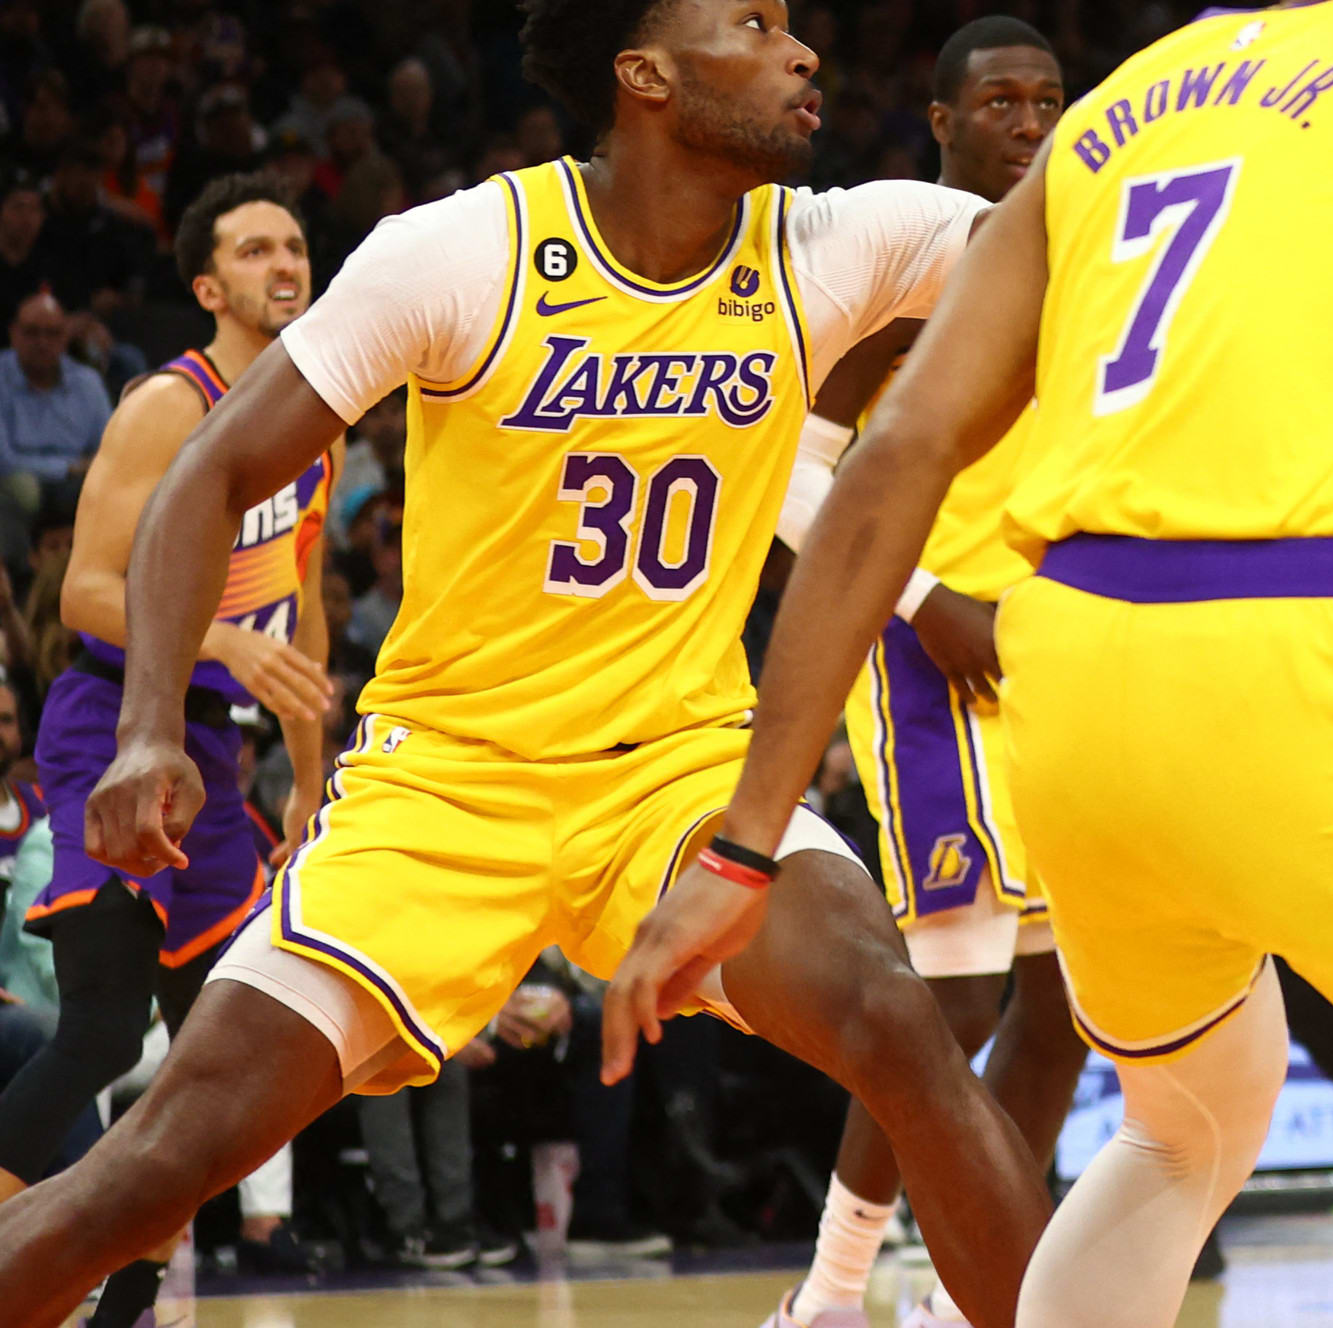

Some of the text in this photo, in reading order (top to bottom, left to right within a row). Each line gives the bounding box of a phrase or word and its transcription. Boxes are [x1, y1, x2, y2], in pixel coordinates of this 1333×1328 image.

[1073, 59, 1267, 174] BROWN
[541, 243, 569, 279] 6
[717, 296, 775, 323] bibigo
[1093, 156, 1243, 417] 7
[497, 333, 779, 433] LAKERS
[543, 451, 722, 602] 30
